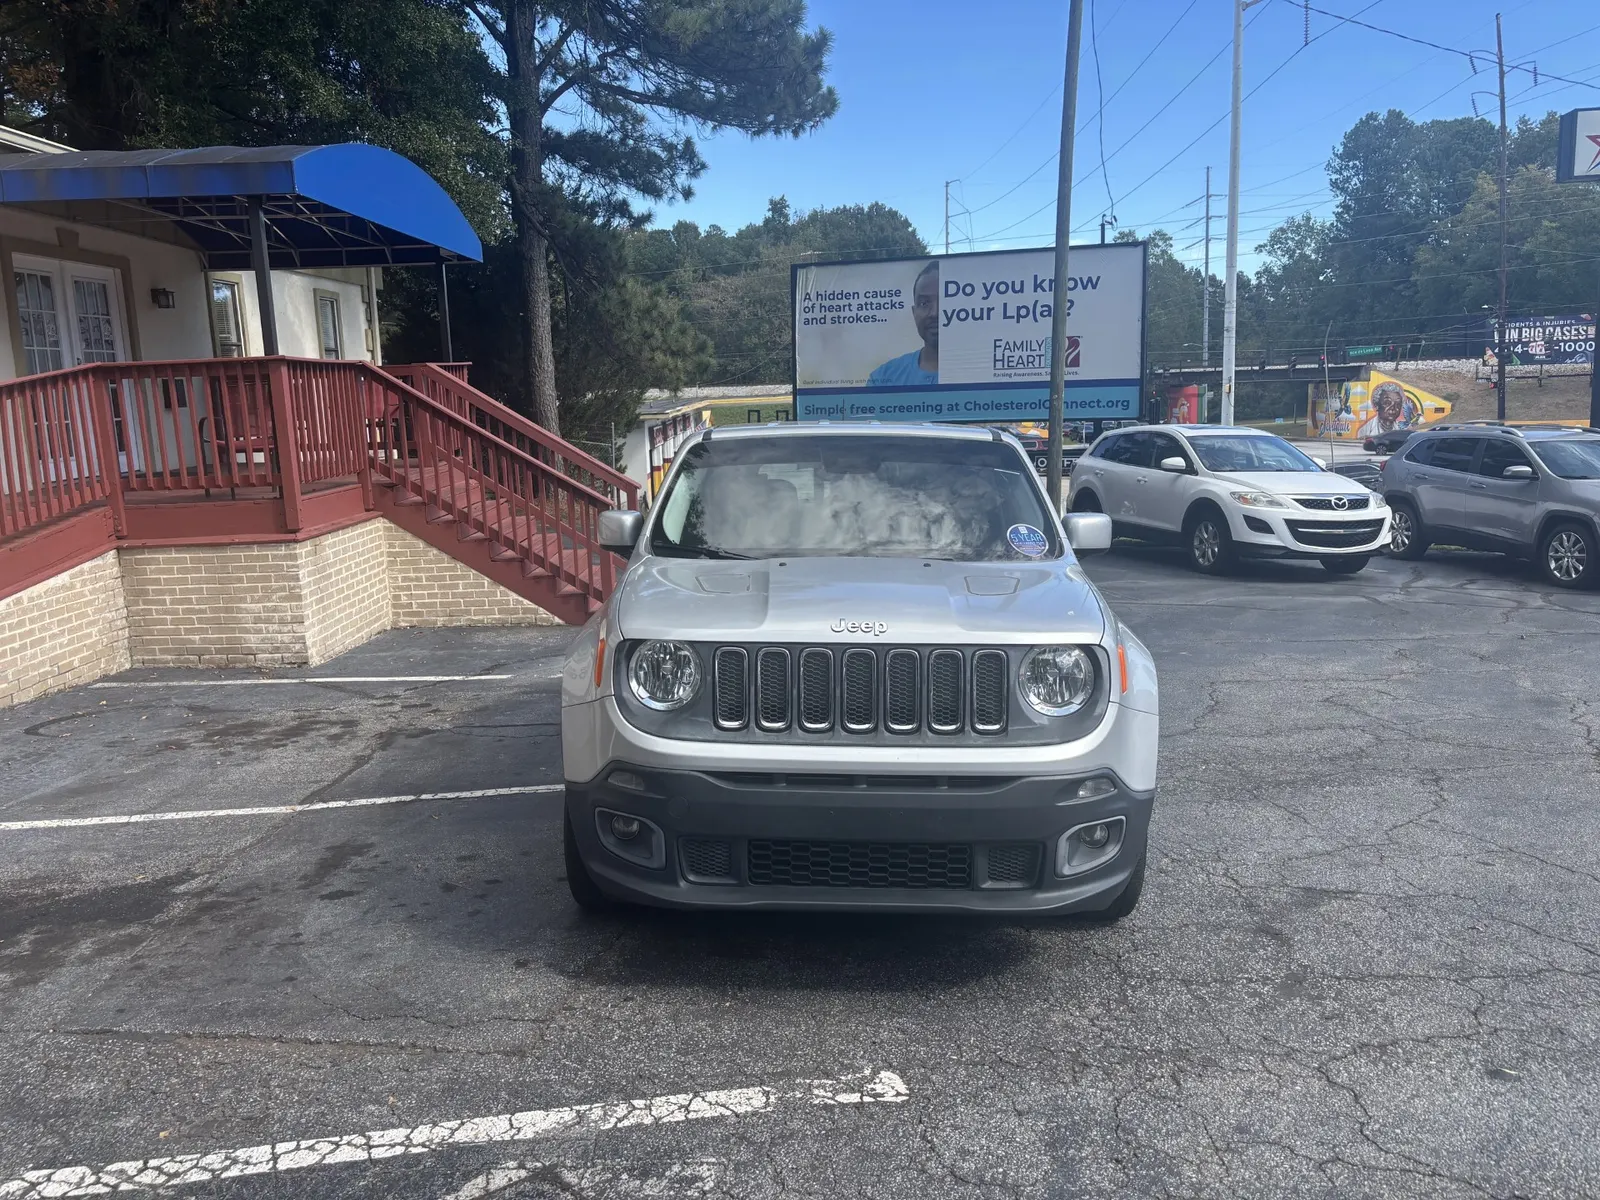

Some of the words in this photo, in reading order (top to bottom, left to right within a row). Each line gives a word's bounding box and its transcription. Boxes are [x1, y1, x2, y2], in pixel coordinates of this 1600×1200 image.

[803, 292, 813, 303] A
[815, 290, 860, 302] hidden
[863, 288, 902, 299] cause
[944, 280, 976, 298] Do
[981, 280, 1025, 300] you
[803, 304, 816, 314] of
[819, 301, 853, 313] heart
[856, 299, 905, 311] attacks
[942, 306, 995, 327] your
[1002, 299, 1075, 323] Lp(a?
[803, 314, 827, 326] and
[830, 312, 887, 325] strokes...
[1521, 328, 1543, 342] BIG
[1545, 325, 1587, 341] CASES
[993, 339, 1045, 353] FAMILY
[993, 353, 1045, 368] HEART
[804, 404, 846, 416] Simple
[850, 403, 876, 414] free
[879, 401, 943, 415] screening
[946, 401, 960, 412] at
[1010, 533, 1018, 542] 5
[1018, 533, 1043, 542] YEAR
[830, 617, 888, 637] Jeep
